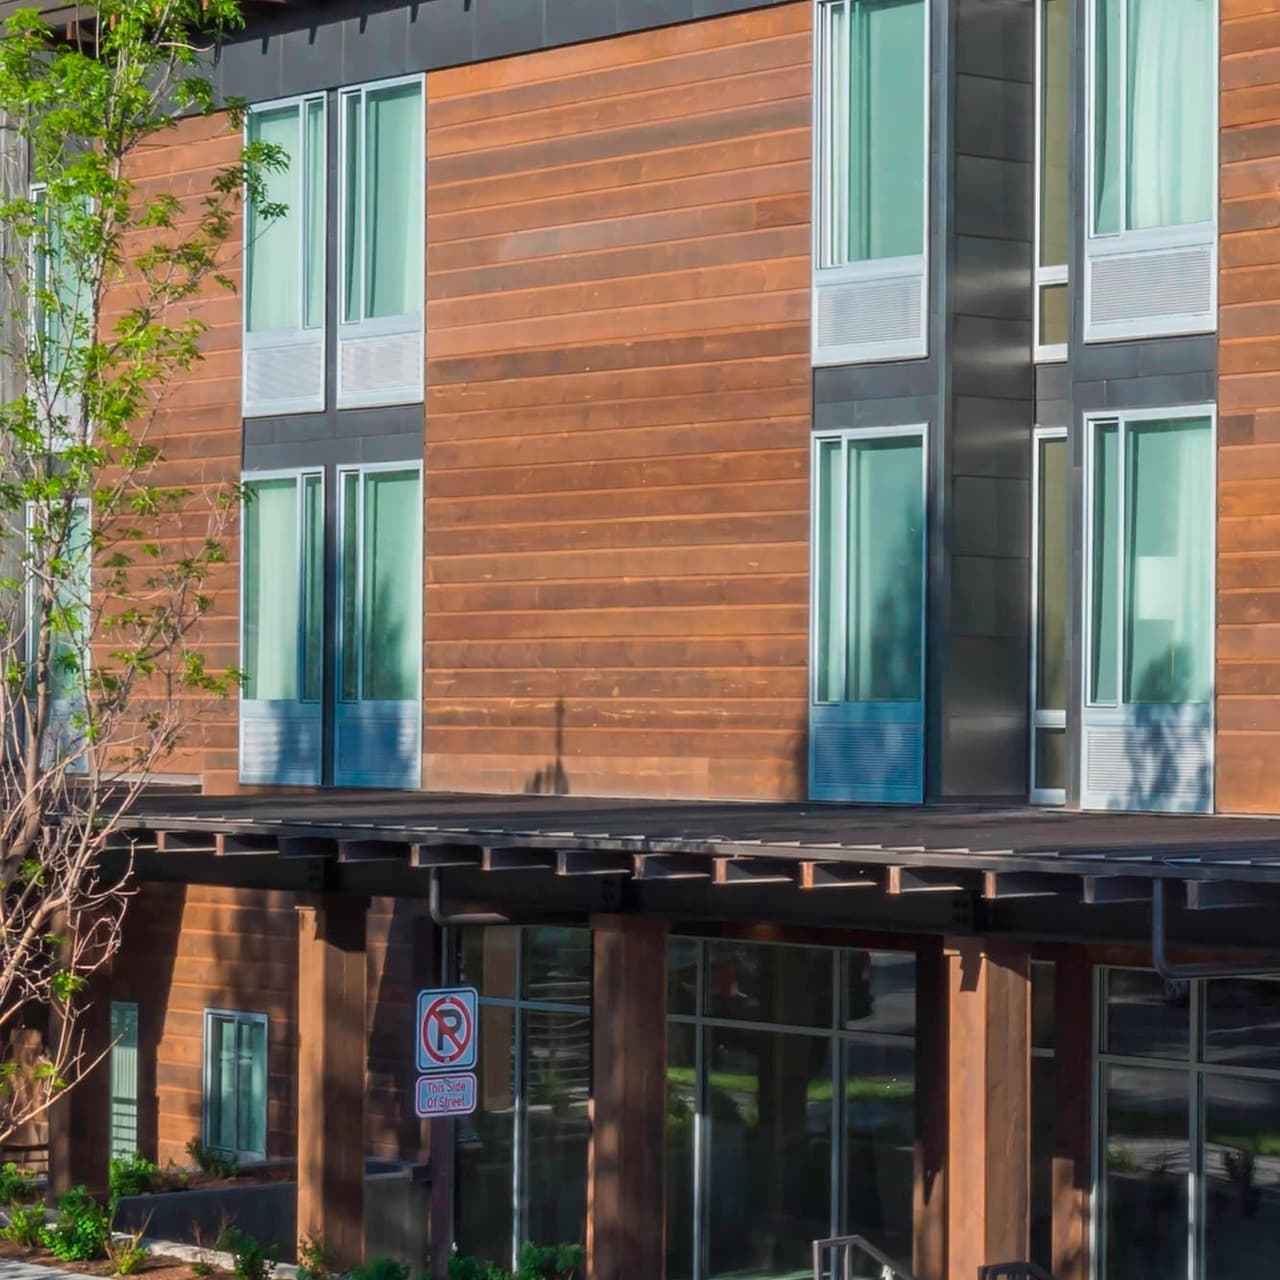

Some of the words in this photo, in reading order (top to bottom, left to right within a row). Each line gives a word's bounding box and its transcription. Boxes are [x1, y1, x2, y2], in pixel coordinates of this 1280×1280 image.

[427, 1082, 445, 1093] This
[447, 1081, 466, 1092] Side
[427, 1097, 437, 1108] Of
[439, 1096, 465, 1108] Street
